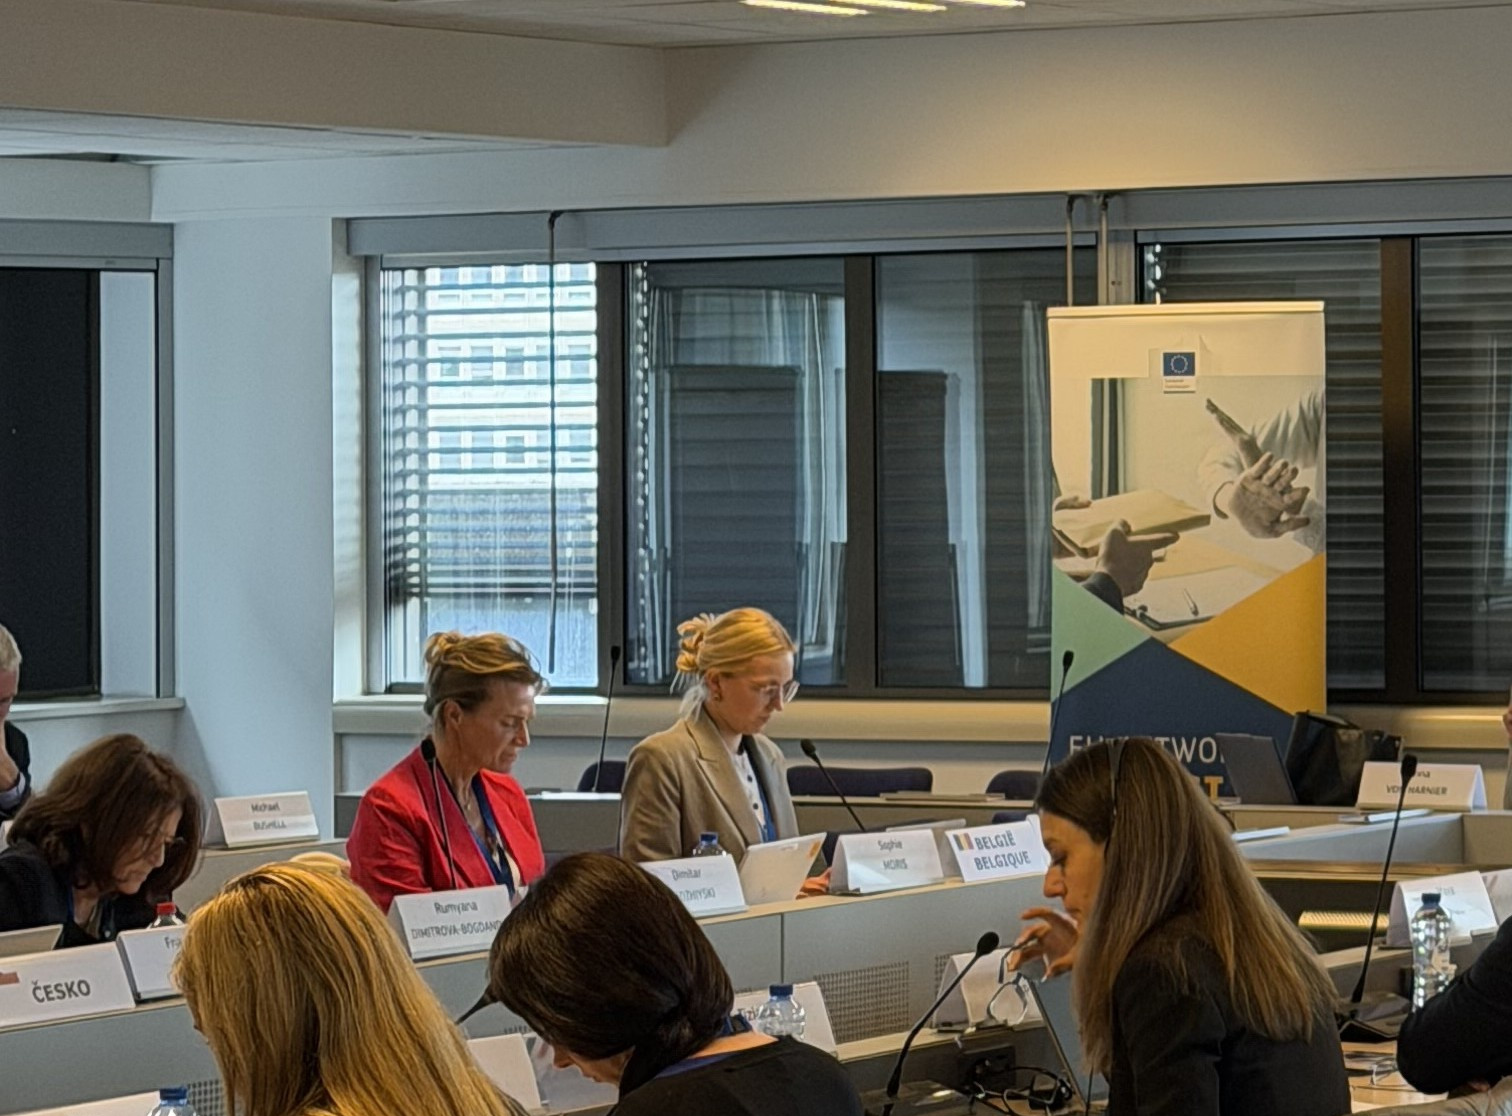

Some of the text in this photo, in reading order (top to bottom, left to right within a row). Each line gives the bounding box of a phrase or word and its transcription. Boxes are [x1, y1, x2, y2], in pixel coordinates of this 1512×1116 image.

[974, 831, 1016, 851] BELGIË
[973, 851, 1031, 871] BELGIQUE
[433, 901, 478, 914] Rumyana
[32, 979, 91, 1003] ČESKO
